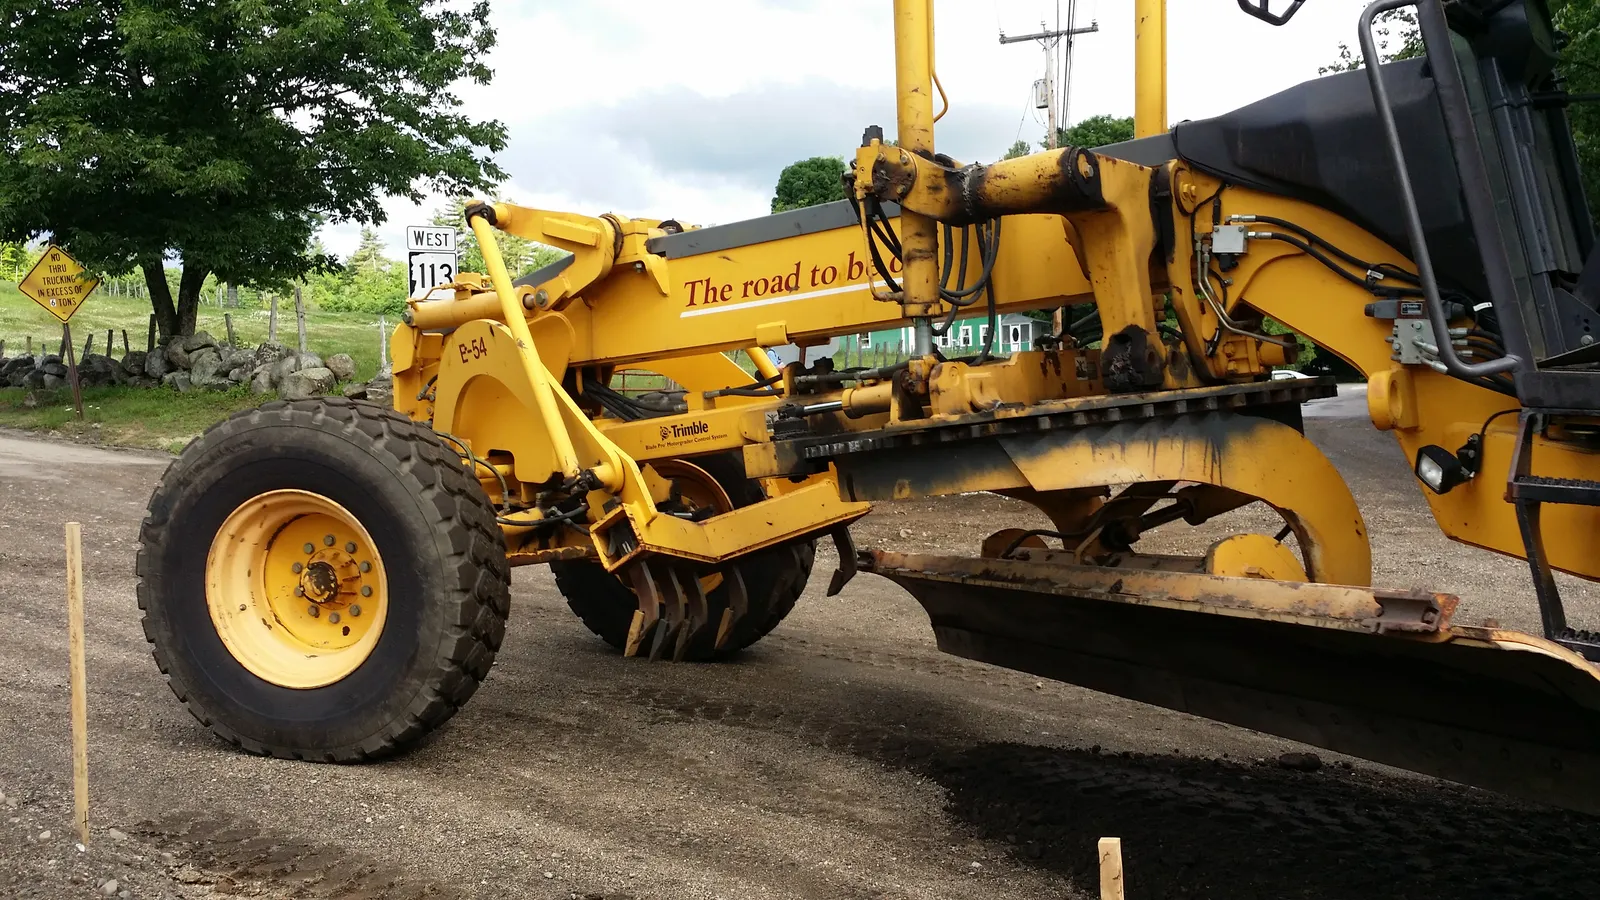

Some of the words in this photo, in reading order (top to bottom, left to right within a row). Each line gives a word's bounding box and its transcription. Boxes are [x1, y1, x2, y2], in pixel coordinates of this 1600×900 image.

[413, 230, 450, 247] WEST
[51, 253, 60, 262] NO
[49, 264, 67, 274] THRU
[42, 275, 76, 286] TRUCKING
[419, 262, 454, 290] 113
[683, 276, 733, 307] The
[741, 261, 802, 299] road
[810, 264, 838, 287] to
[38, 289, 45, 298] IN
[46, 286, 74, 297] EXCESS
[74, 285, 82, 294] OF
[58, 297, 76, 307] TONS
[458, 336, 488, 364] E-54
[671, 420, 709, 438] Trimble
[666, 439, 694, 447] Motorgrader
